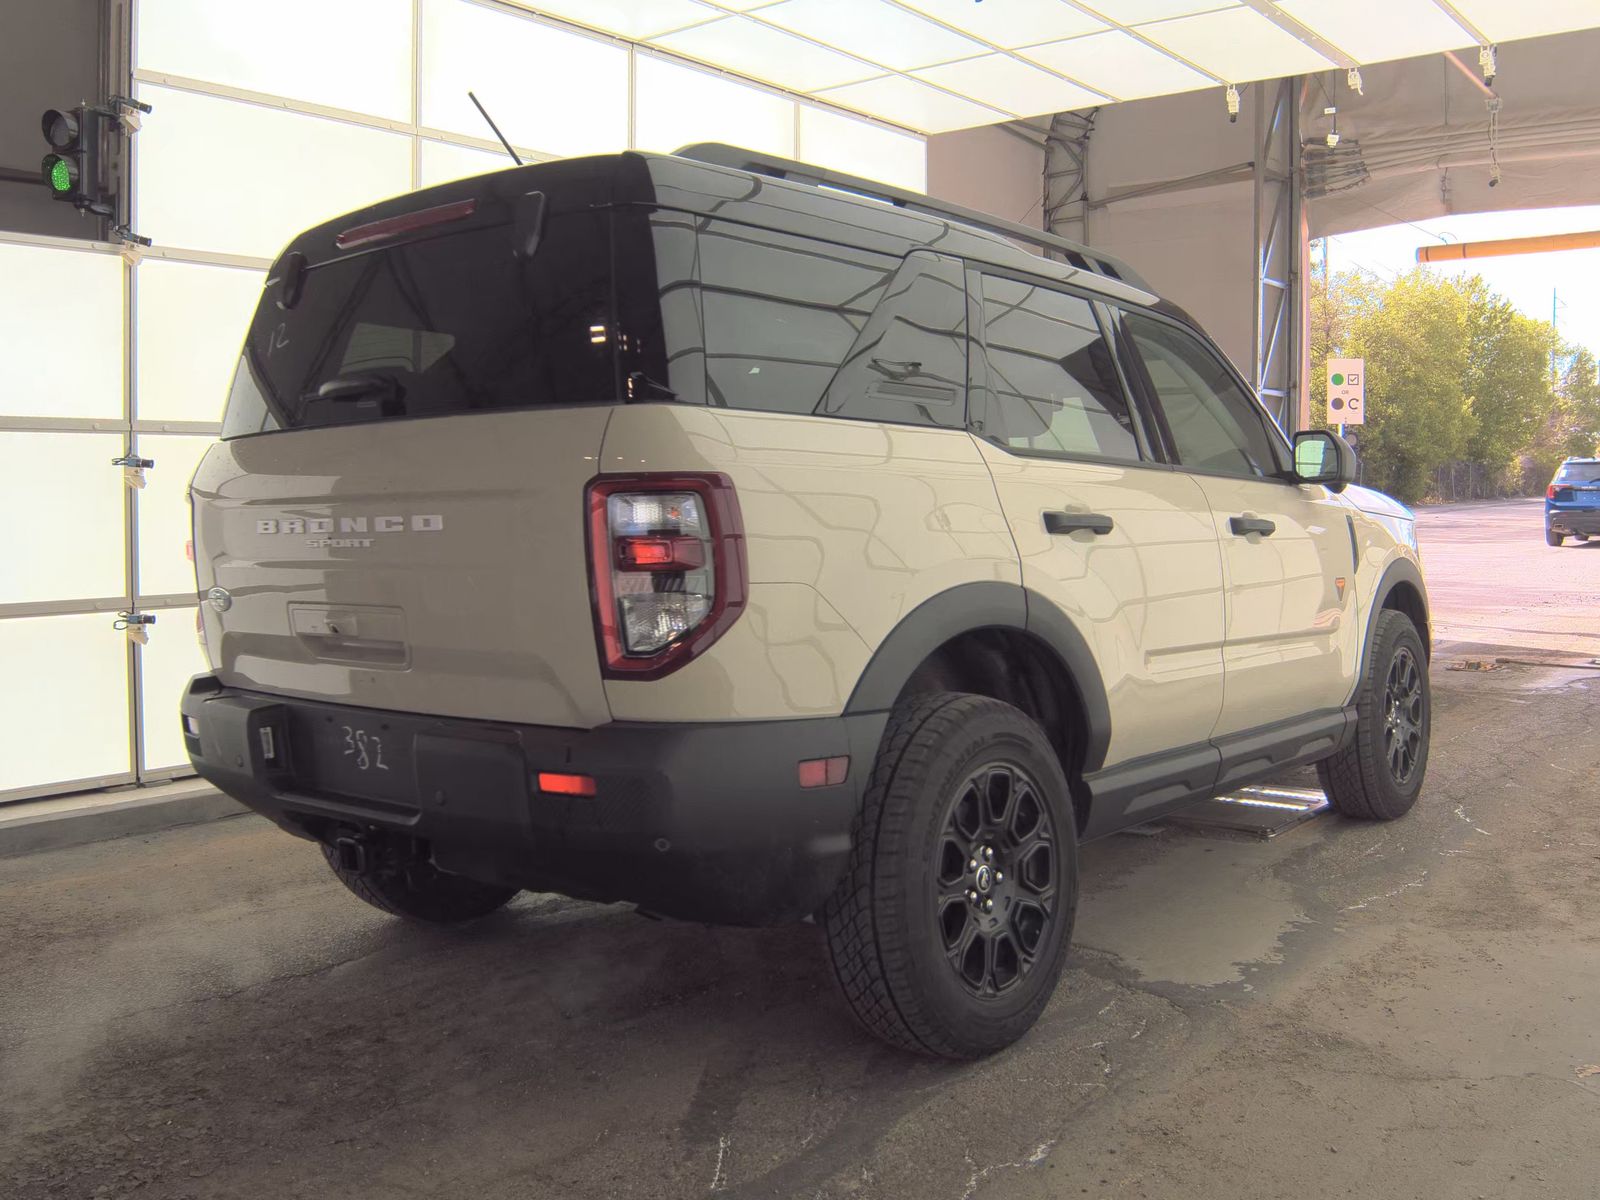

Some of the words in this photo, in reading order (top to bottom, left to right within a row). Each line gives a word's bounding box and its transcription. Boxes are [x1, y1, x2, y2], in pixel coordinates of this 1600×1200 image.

[256, 514, 444, 535] BRONCO
[305, 538, 375, 549] SPORT
[341, 726, 389, 770] 382
